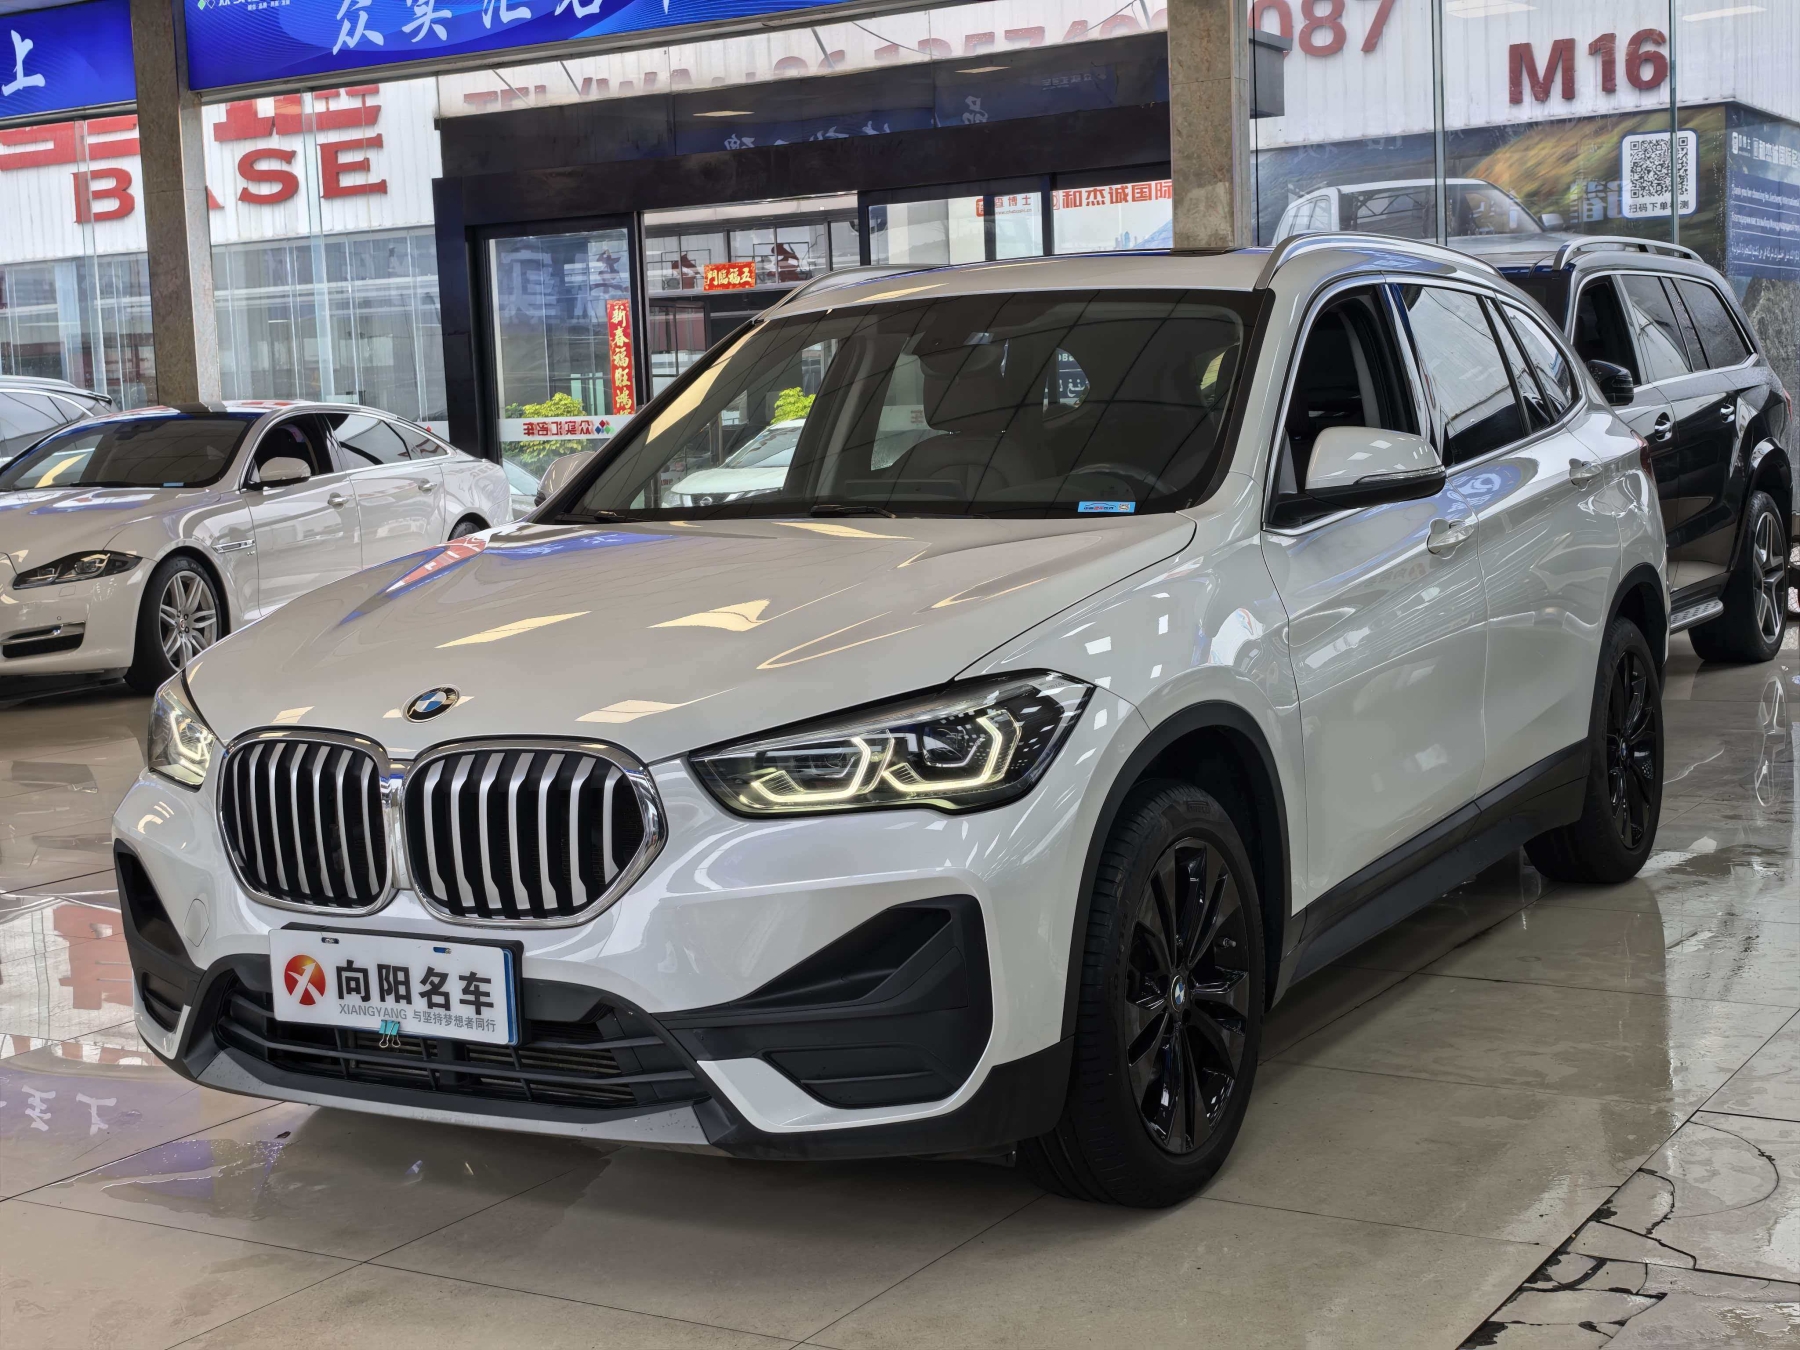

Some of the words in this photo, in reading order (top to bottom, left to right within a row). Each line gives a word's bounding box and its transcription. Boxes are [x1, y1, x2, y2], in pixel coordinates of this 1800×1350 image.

[1, 29, 46, 96] 上
[1509, 28, 1669, 104] M16
[72, 133, 388, 224] BSE
[1628, 200, 1689, 213] 扫码下单测
[336, 959, 494, 1015] 向阳名车
[339, 1003, 408, 1020] XIANGYANG
[412, 1010, 497, 1033] 与坚持梦想者同行
